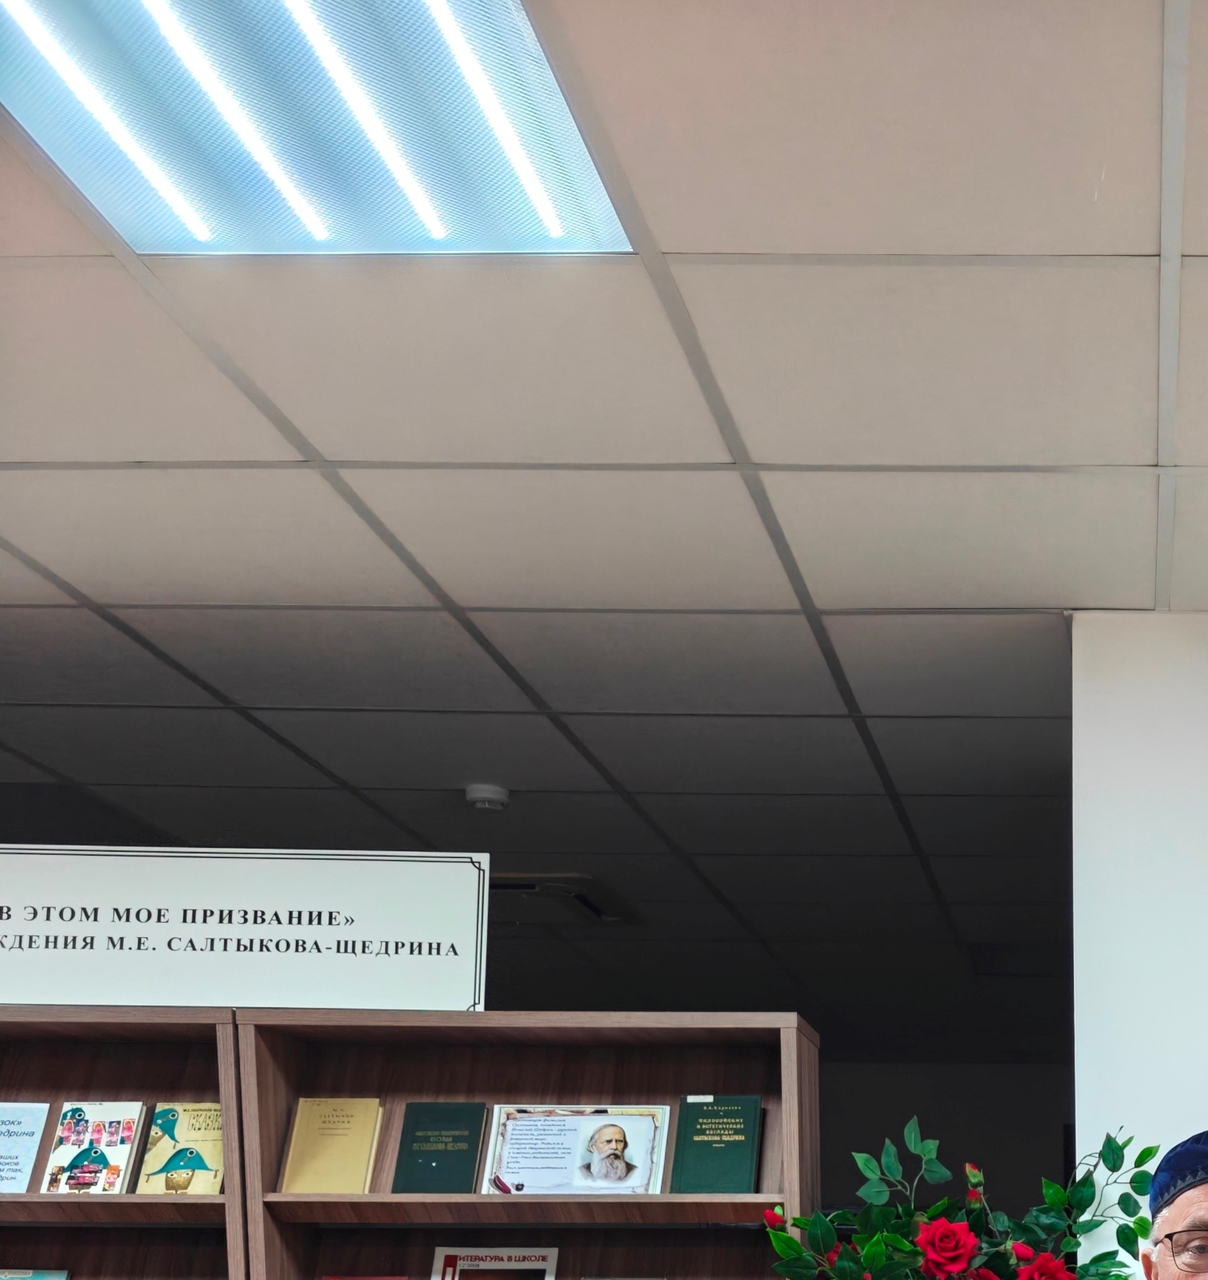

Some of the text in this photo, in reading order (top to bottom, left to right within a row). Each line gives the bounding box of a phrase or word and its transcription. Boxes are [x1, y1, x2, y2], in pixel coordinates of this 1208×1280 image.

[23, 905, 100, 922] ЭТОМ
[111, 907, 170, 923] МОЕ
[181, 908, 355, 926] ПРИЗВАНИЕ»
[106, 936, 157, 951] М.Е.
[167, 936, 460, 957] САЛТЫКОВА-ЩЕДРИНА
[514, 1254, 548, 1262] ШКОЛЕ
